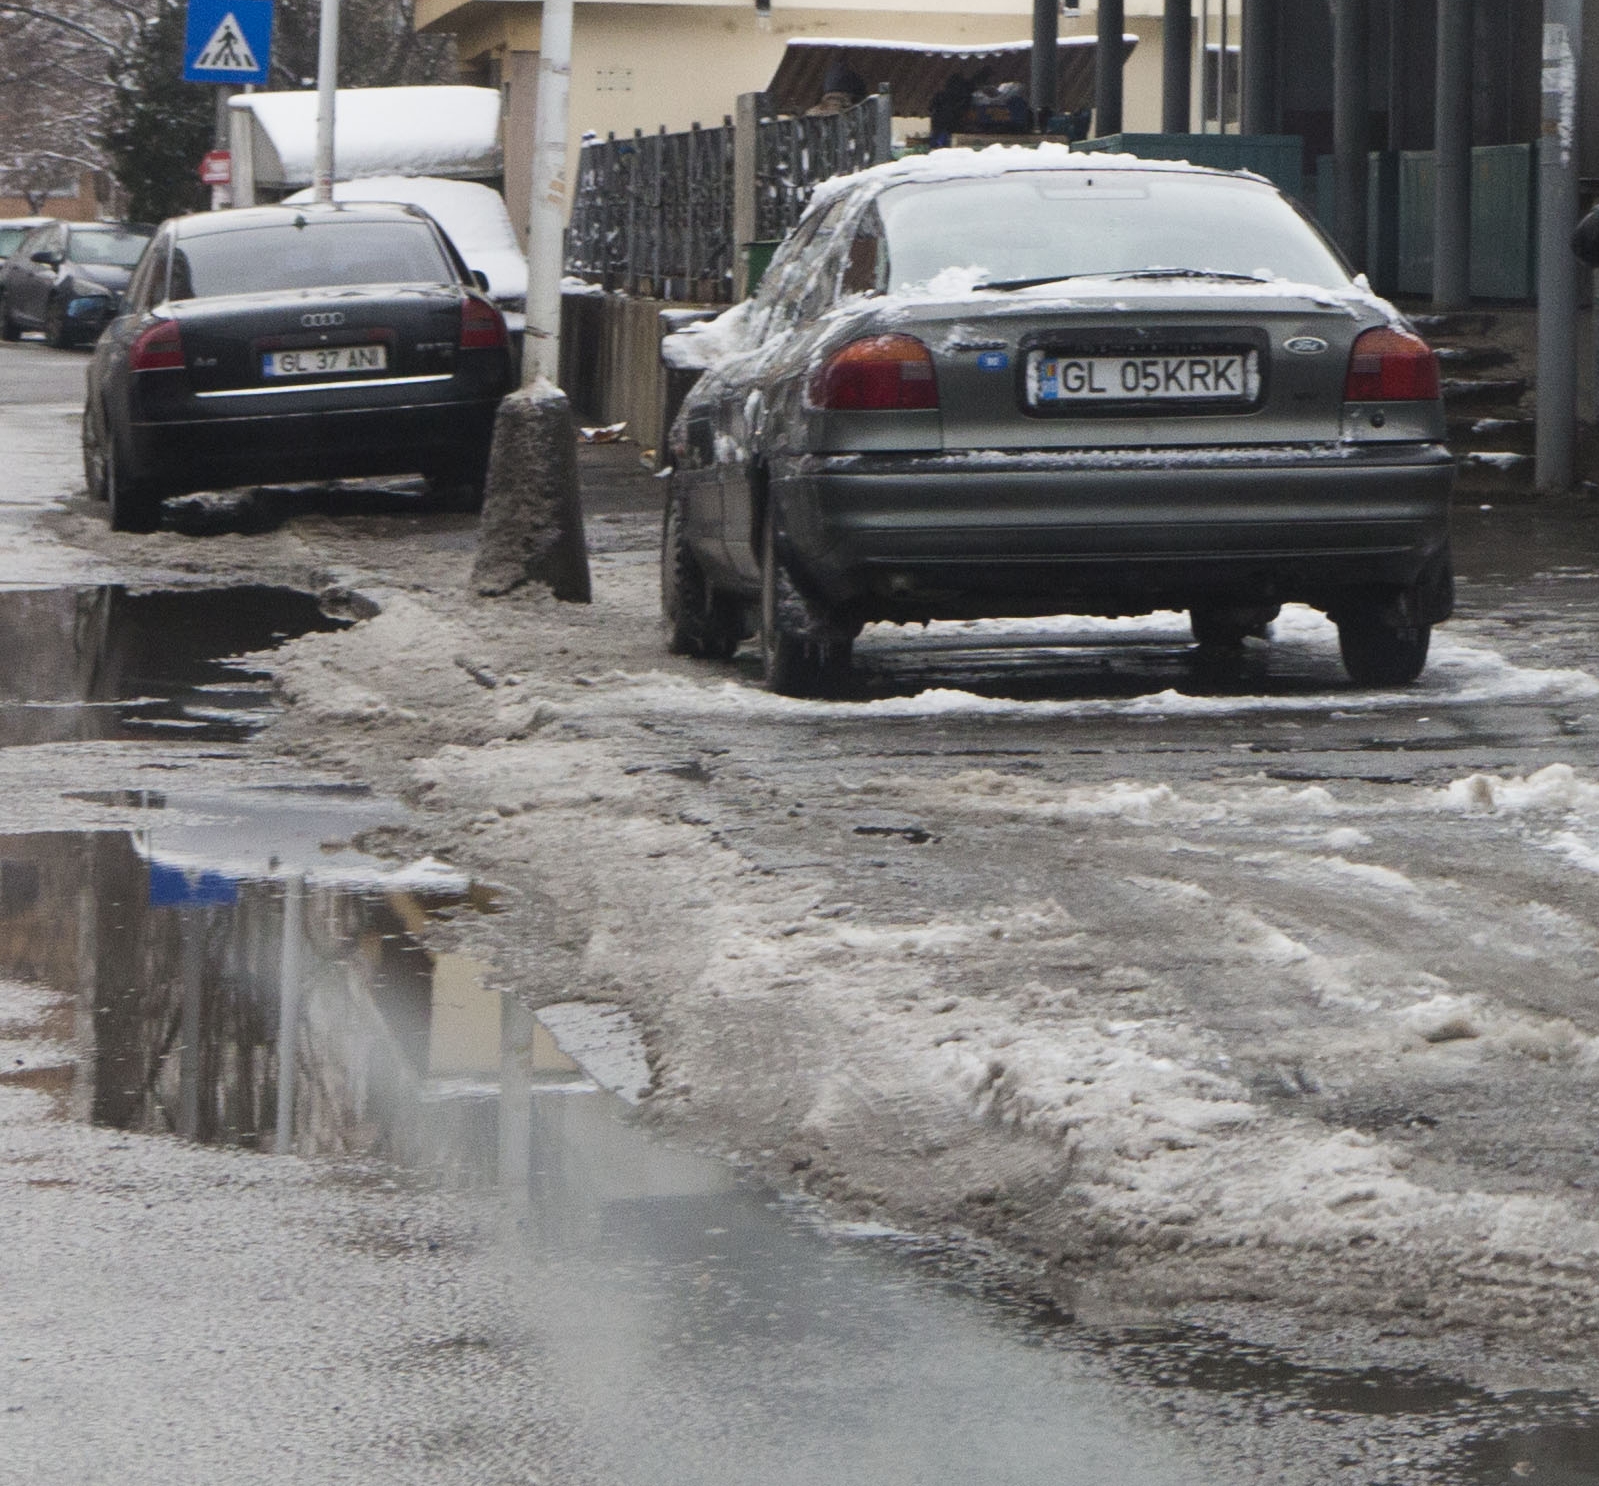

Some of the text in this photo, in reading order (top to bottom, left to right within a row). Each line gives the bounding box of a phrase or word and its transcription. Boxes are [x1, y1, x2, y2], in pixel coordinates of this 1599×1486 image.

[279, 353, 307, 373] GL
[315, 350, 340, 371] 37
[1063, 357, 1238, 394] GL 05KRK
